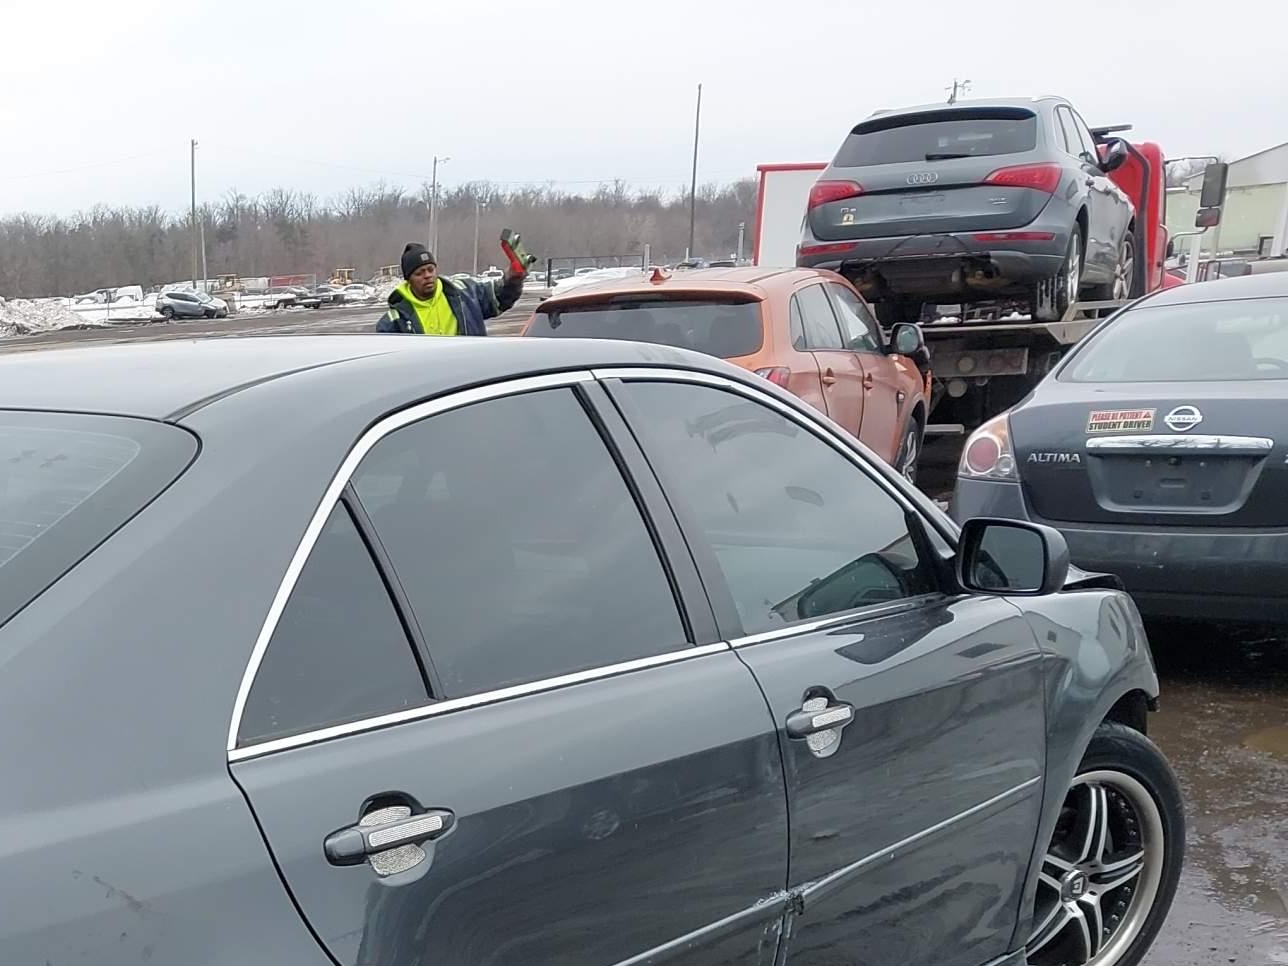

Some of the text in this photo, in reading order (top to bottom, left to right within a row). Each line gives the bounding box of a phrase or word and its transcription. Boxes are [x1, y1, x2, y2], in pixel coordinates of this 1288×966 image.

[1089, 420, 1152, 430] STUDENT DRIVER
[1026, 453, 1081, 463] ALTIMA
